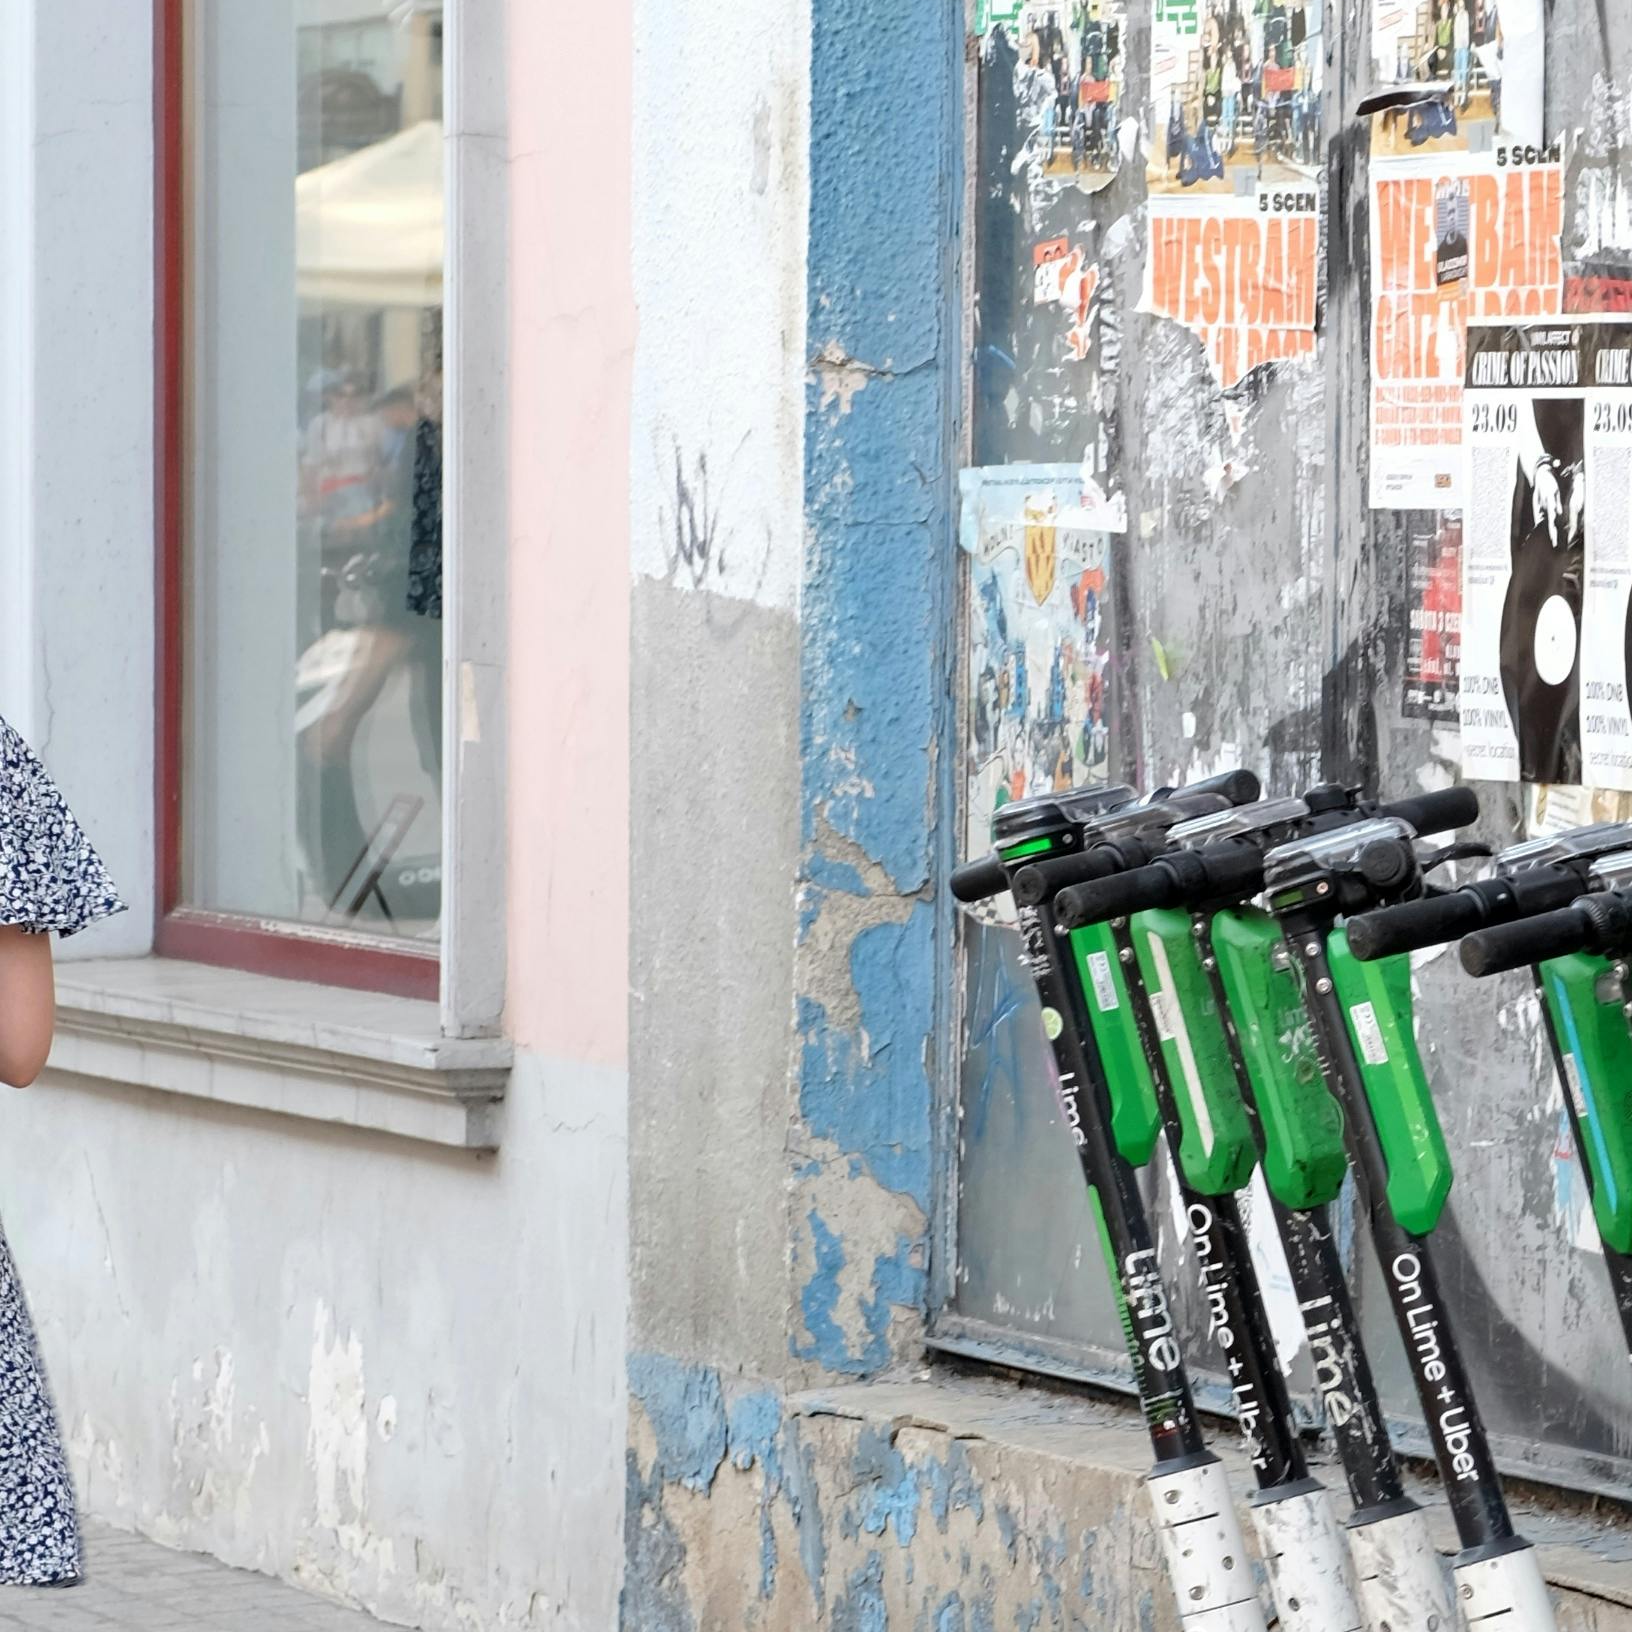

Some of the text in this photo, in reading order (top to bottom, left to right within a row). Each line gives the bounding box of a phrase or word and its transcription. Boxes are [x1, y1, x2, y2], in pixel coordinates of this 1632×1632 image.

[1497, 147, 1507, 166] 5
[1259, 193, 1316, 212] 5 SCEN
[1376, 170, 1562, 292] WEBAM
[1152, 217, 1317, 325] WESTBAM
[1471, 348, 1580, 385] CRIME OF PASSION
[1595, 349, 1629, 384] CRIME
[1472, 403, 1518, 433] 23.09
[1058, 1071, 1087, 1148] Lime
[1124, 1247, 1181, 1372] Lime
[1187, 1202, 1212, 1258] On
[1202, 1261, 1234, 1349] Lime
[1392, 1253, 1422, 1304] On
[1300, 1294, 1353, 1427] Lime
[1406, 1304, 1446, 1382] Lime
[1439, 1406, 1480, 1481] Uber
